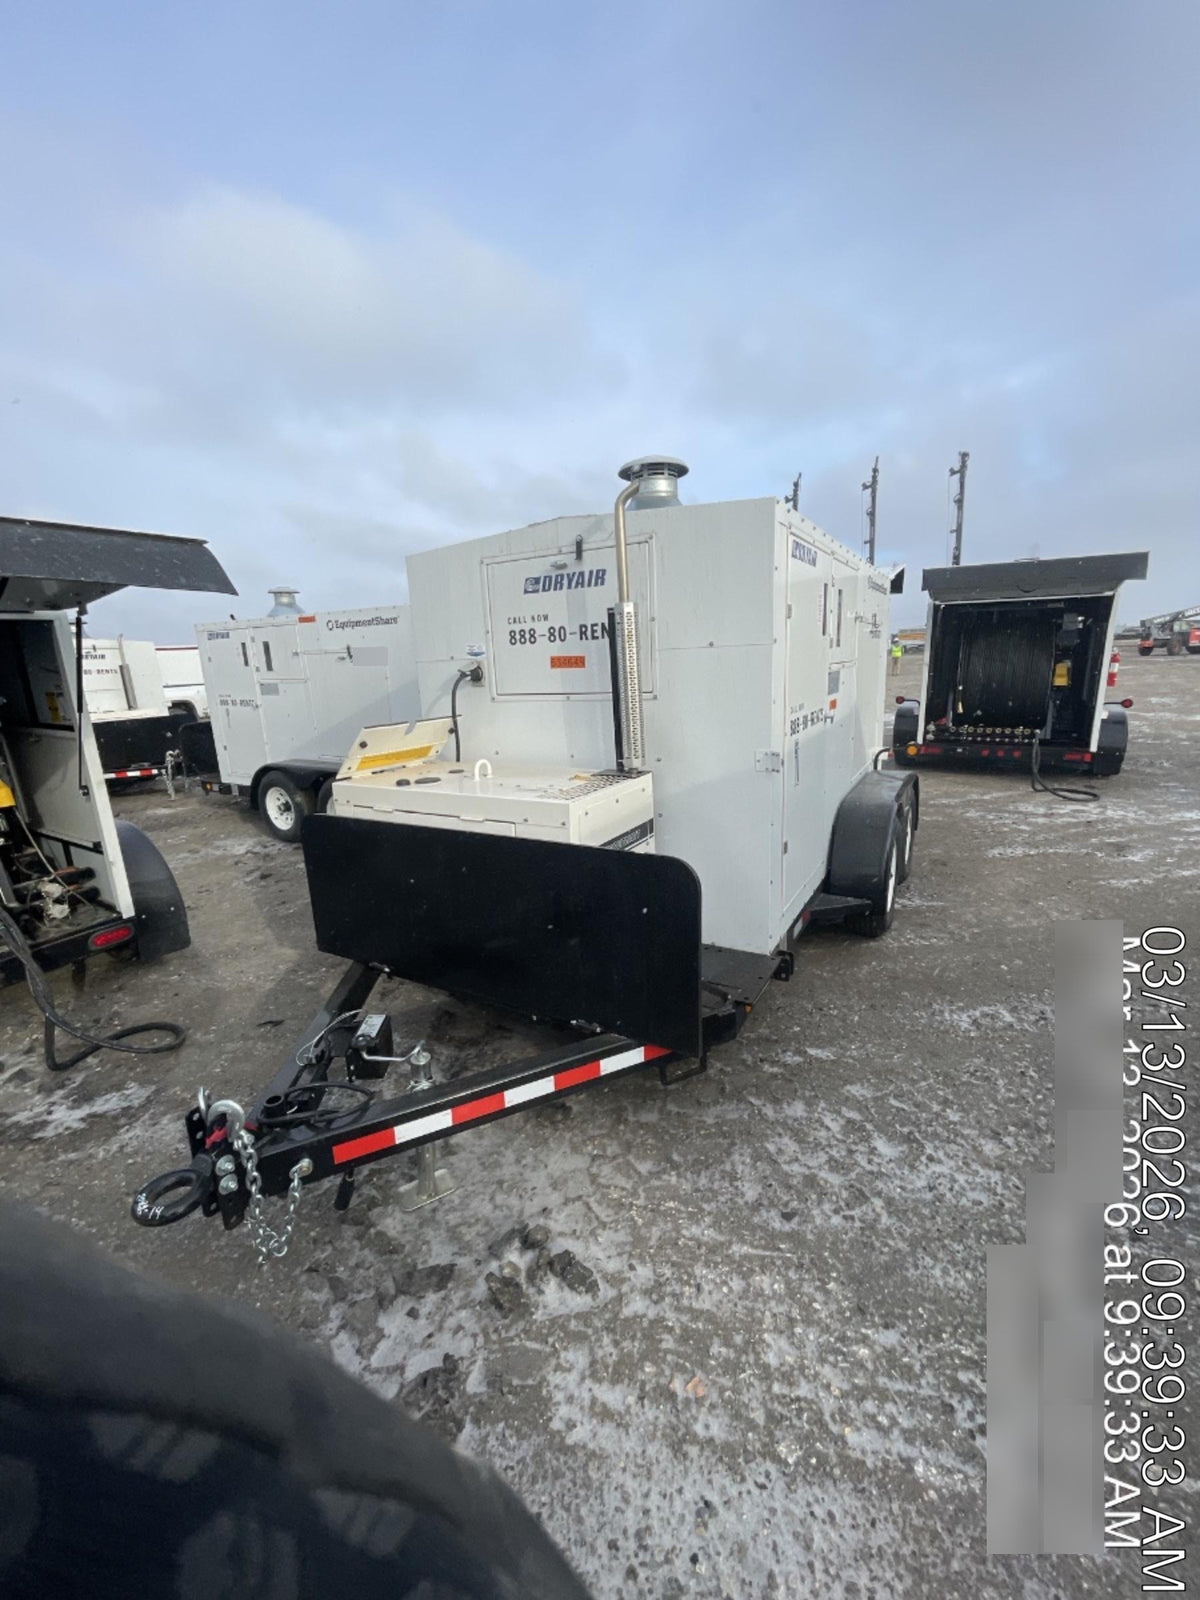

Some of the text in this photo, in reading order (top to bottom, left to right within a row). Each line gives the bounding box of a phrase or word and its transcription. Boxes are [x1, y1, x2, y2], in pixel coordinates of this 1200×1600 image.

[541, 569, 607, 592] DRYAIR
[334, 616, 399, 630] EquipmentShare
[507, 615, 528, 625] CALL
